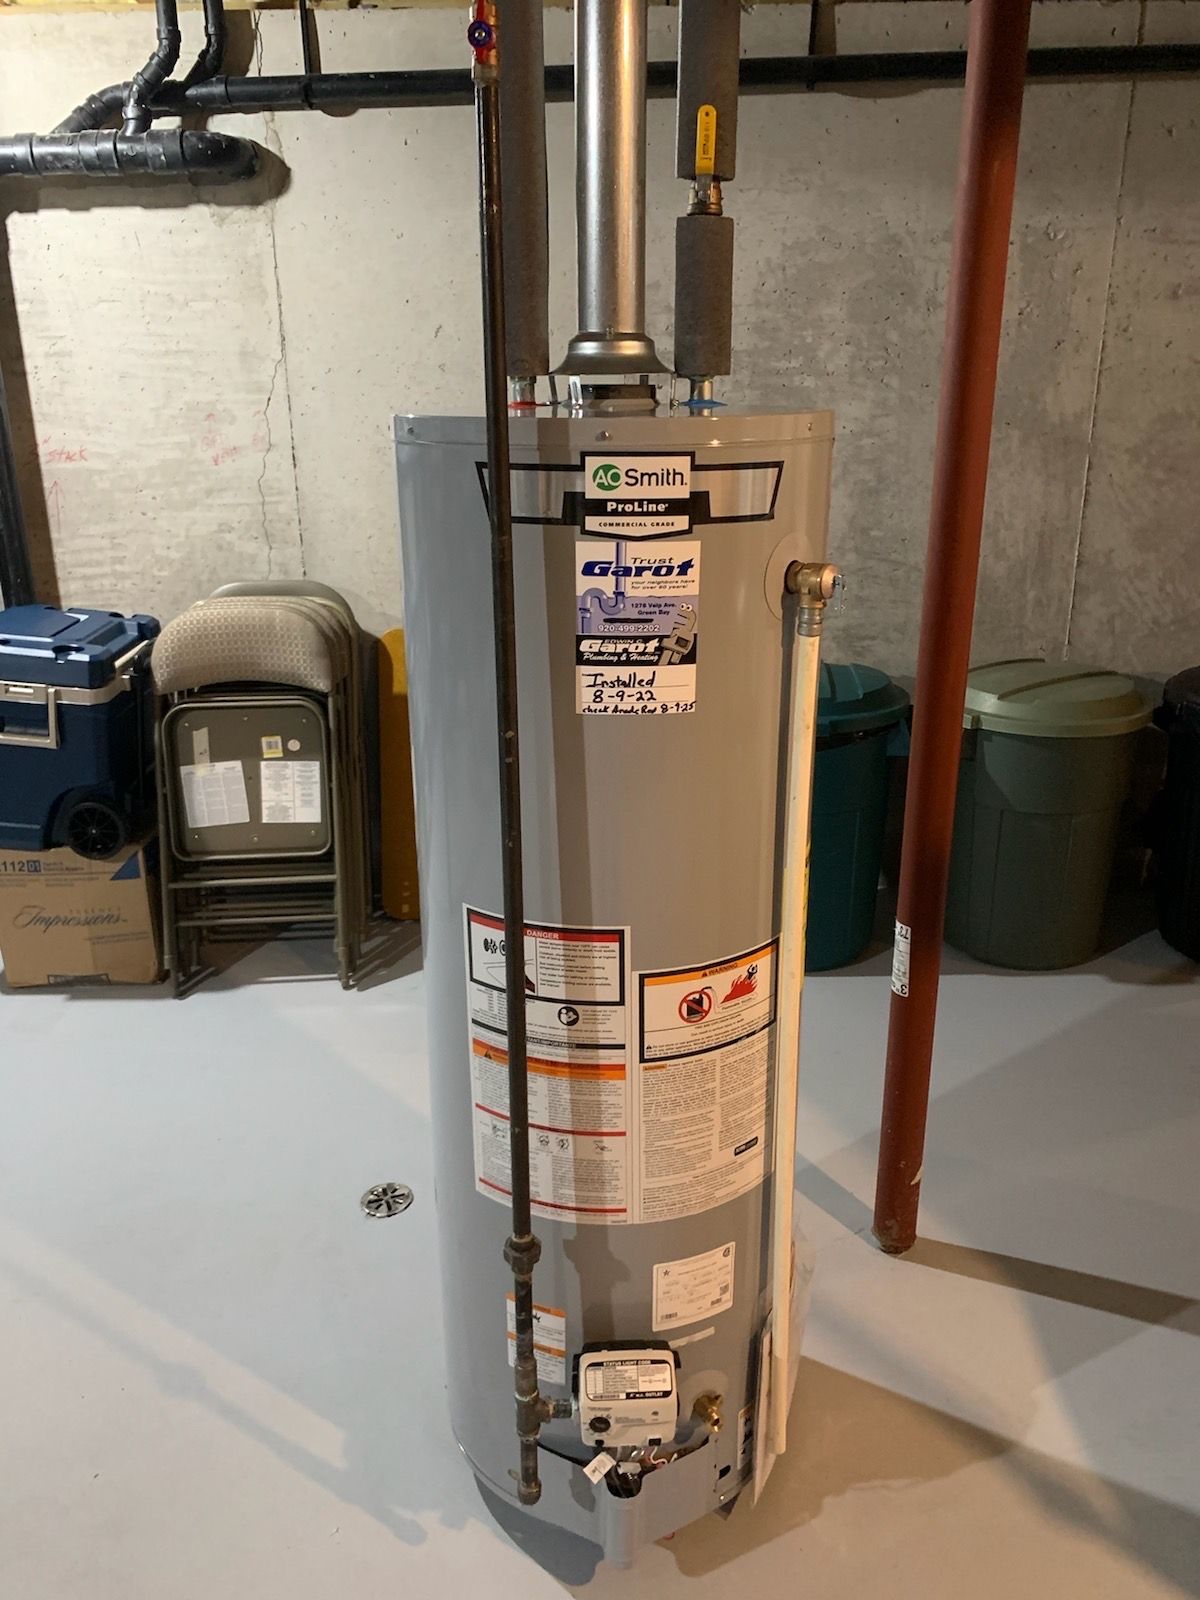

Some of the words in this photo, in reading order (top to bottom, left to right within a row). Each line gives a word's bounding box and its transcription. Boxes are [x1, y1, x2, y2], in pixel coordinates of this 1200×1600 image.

[624, 468, 684, 487] Smith
[606, 501, 667, 512] ProLine
[581, 557, 695, 577] Garot
[630, 557, 675, 565] Trust
[579, 637, 660, 653] Garot
[583, 652, 619, 663] Plumbing
[620, 652, 628, 661] &
[628, 653, 659, 663] Heating
[581, 670, 656, 688] Installed
[592, 689, 657, 703] 8-9-22
[526, 929, 560, 940] DANGER
[708, 962, 738, 976] WARNING
